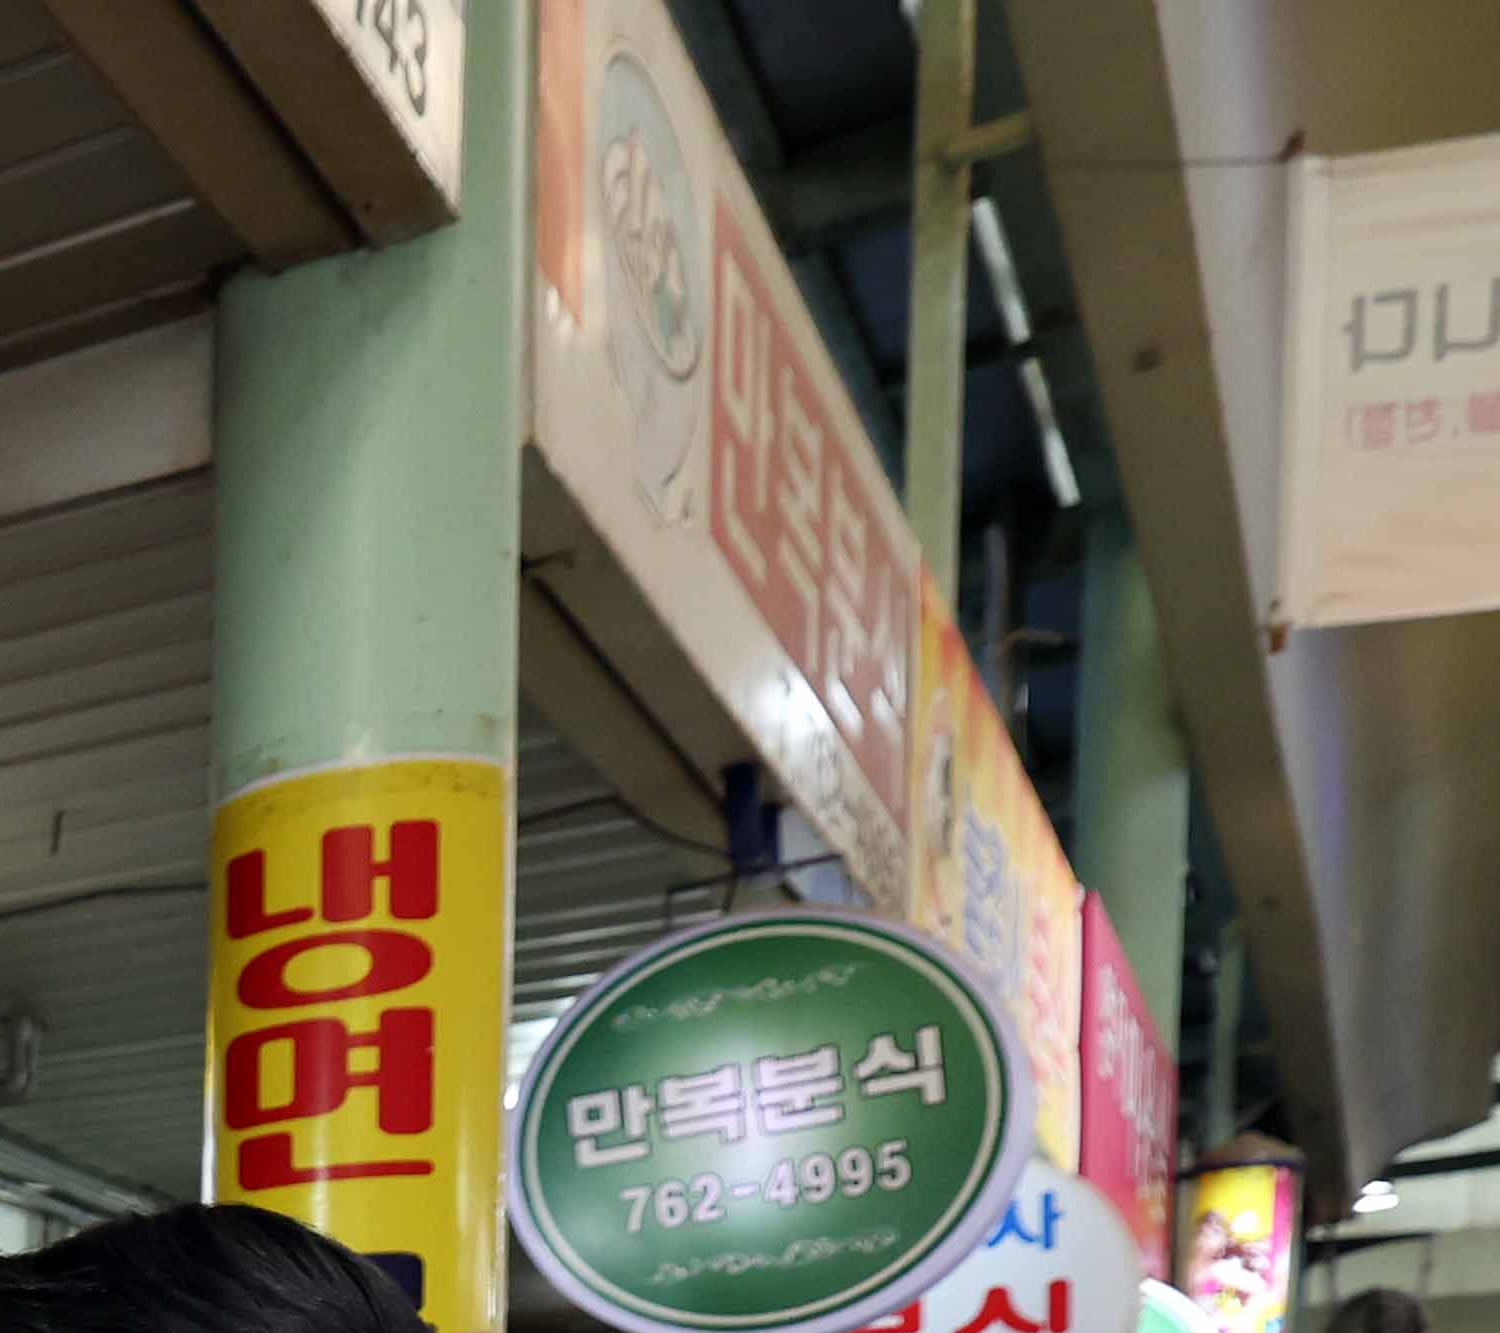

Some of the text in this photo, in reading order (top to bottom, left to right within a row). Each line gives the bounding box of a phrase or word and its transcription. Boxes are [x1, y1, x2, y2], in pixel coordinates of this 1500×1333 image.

[225, 820, 439, 1191] 냉면
[566, 1026, 946, 1169] 만복분식
[620, 1141, 912, 1233] 762-4995
